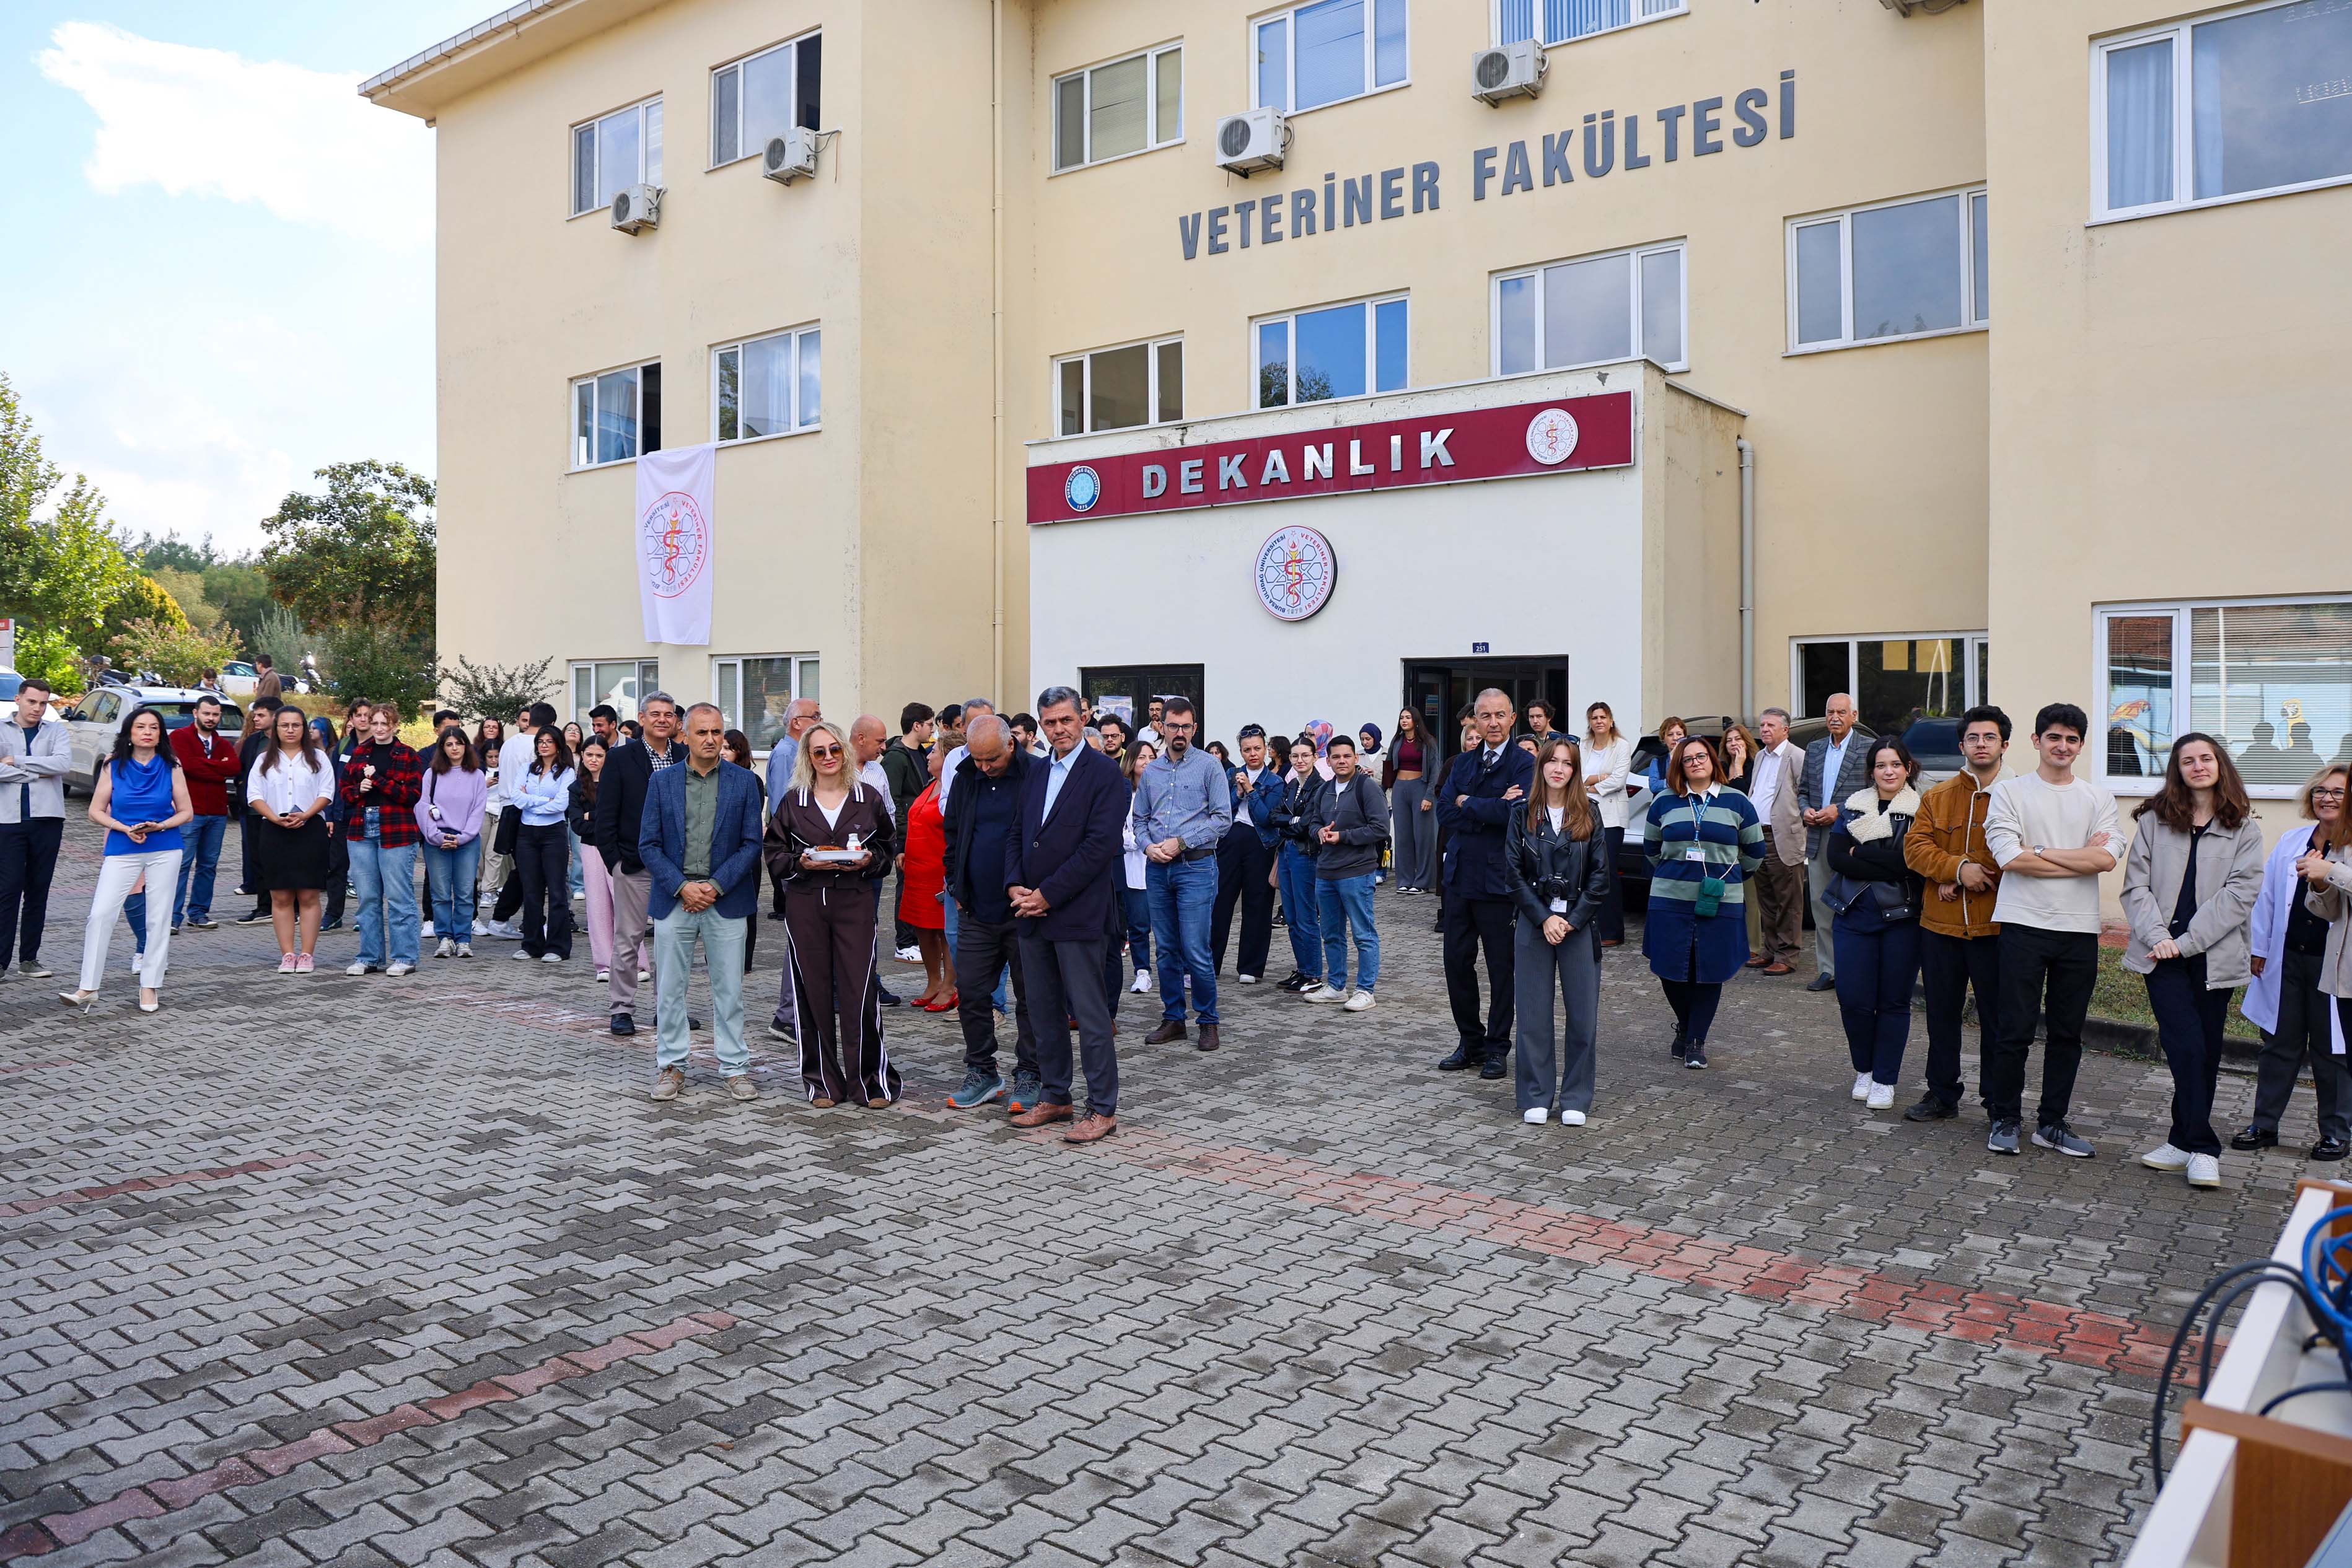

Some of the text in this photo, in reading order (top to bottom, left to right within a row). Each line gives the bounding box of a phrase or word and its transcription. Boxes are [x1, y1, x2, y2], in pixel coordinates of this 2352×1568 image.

[1179, 69, 1795, 260] VETERİNER FAKÜLTESİ
[1143, 428, 1455, 499] DEKANLIK
[678, 500, 703, 589] VETERİNER FAKÜLTESİ
[1258, 533, 1286, 613] BURSA ULUDAĞ ÜNİVERSİTESİ
[1301, 532, 1328, 611] VETERİNER FAKÜLTESİ
